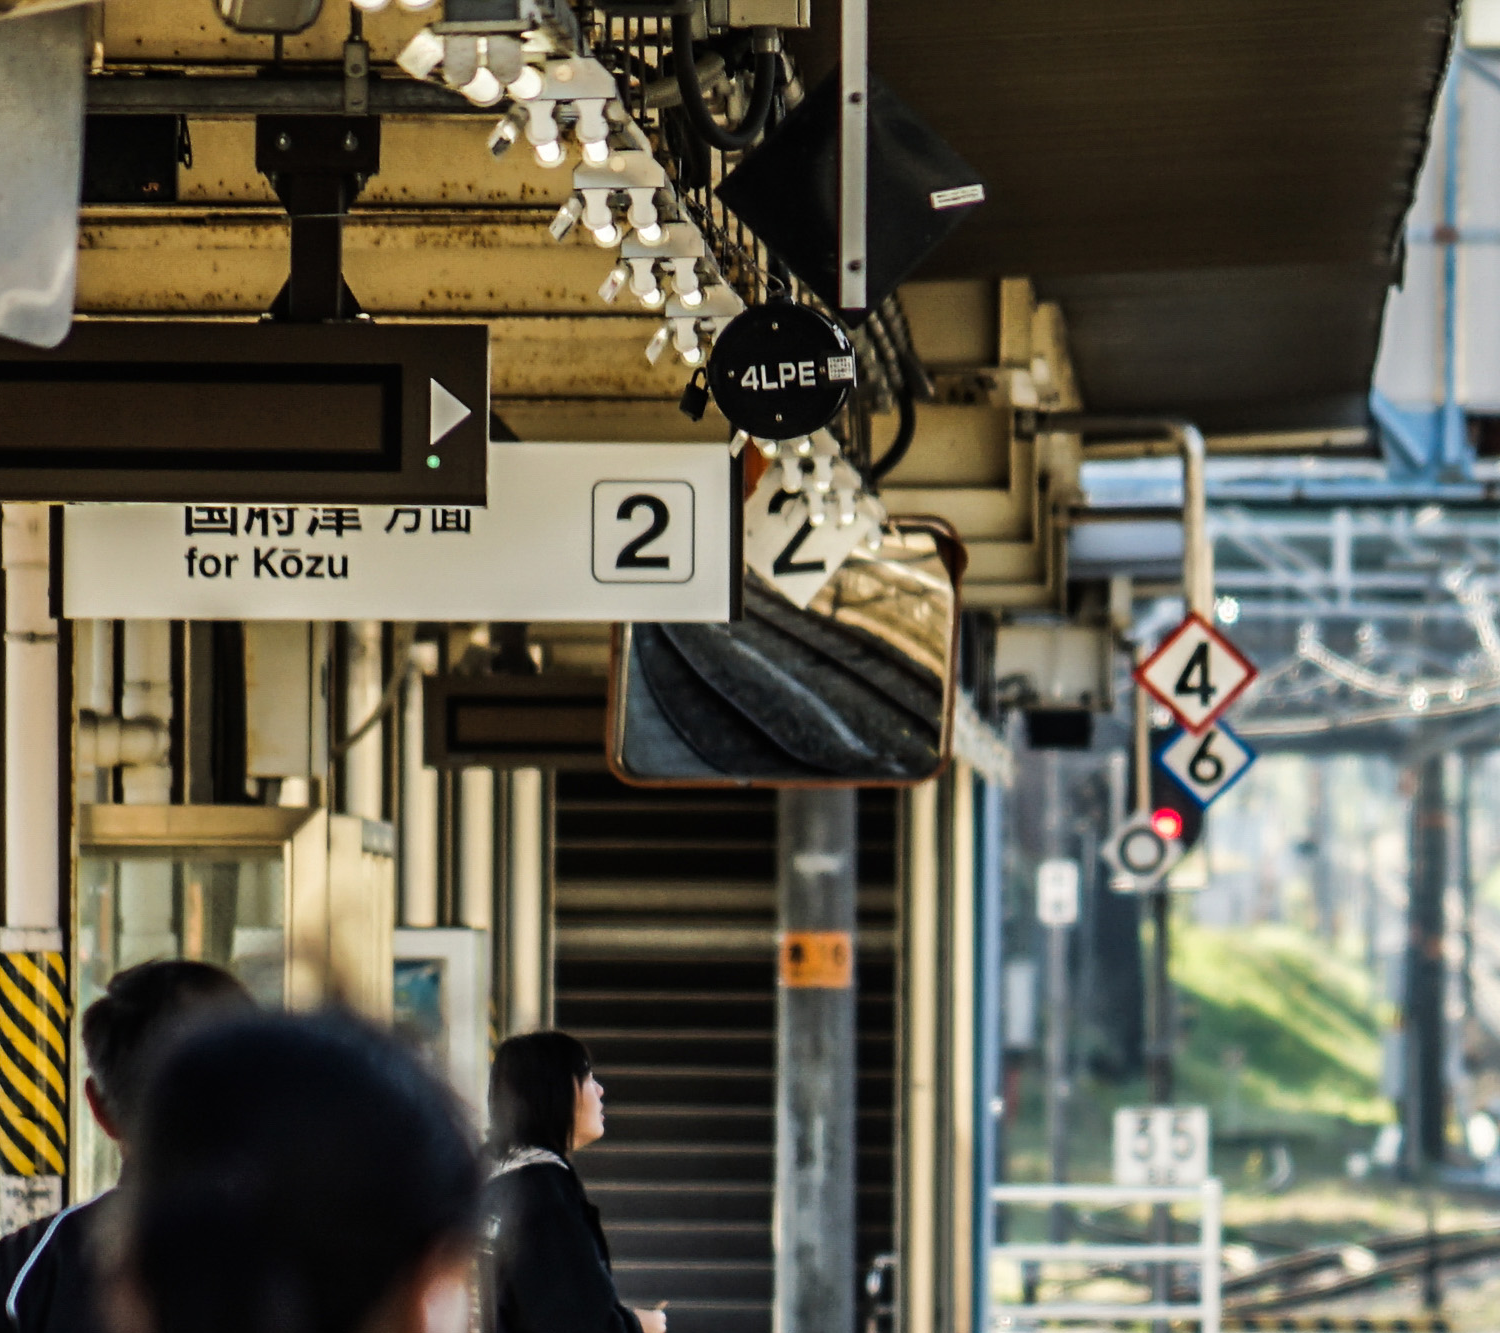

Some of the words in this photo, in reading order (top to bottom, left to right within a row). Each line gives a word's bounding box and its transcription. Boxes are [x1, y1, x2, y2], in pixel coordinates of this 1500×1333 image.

[741, 360, 816, 391] 4LPE
[616, 493, 670, 570] 2
[768, 488, 826, 577] 2
[185, 547, 238, 579] for
[254, 547, 348, 579] Kōzu
[1174, 642, 1217, 707] 4
[1188, 729, 1224, 786] 6
